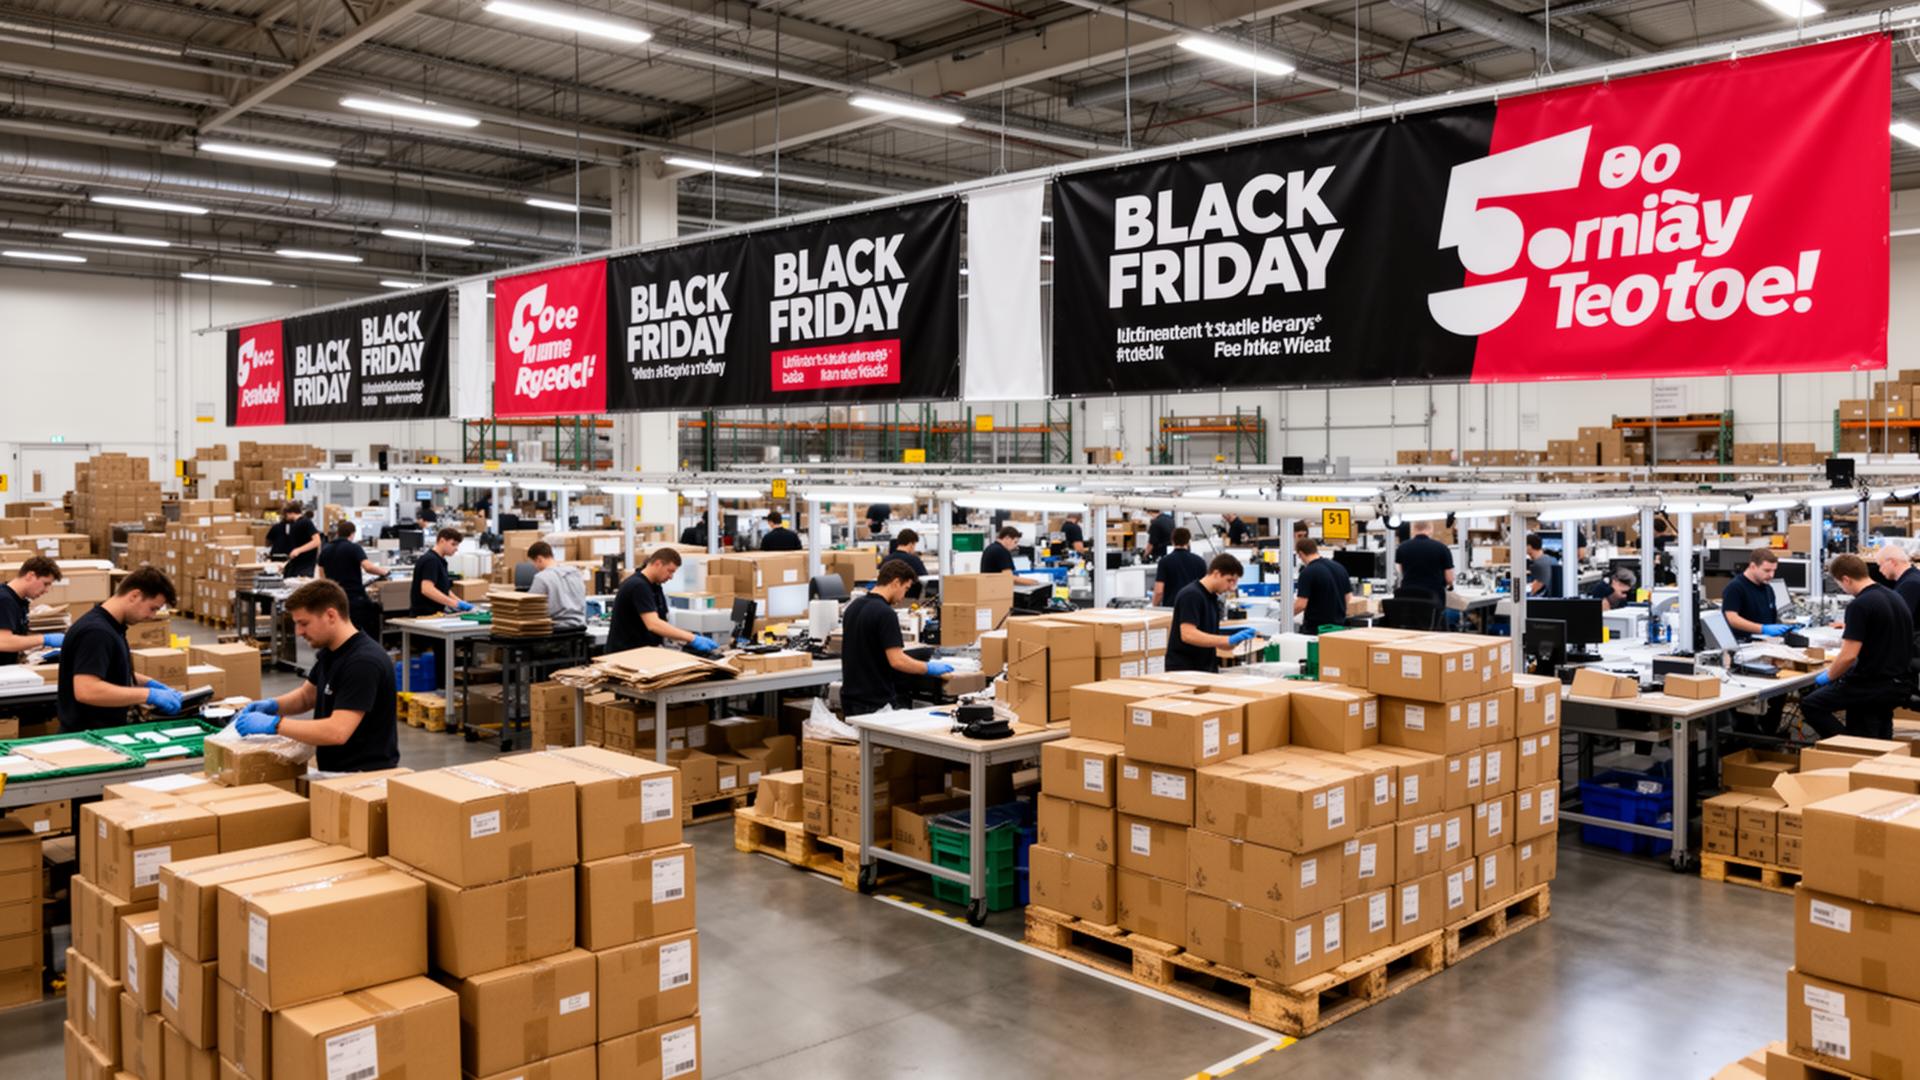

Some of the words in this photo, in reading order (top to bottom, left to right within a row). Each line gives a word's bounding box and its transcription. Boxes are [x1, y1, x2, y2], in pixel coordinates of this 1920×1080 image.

[1114, 165, 1338, 250] BLACK
[774, 233, 906, 298] BLACK
[1109, 228, 1345, 309] FRIDAY
[630, 271, 731, 324] BLACK
[770, 282, 910, 344] FRIDAY
[361, 310, 424, 347] BLACK
[627, 313, 733, 363] FRIDAY
[295, 338, 351, 377] BLACK
[361, 341, 425, 377] FRIDAY
[293, 371, 351, 407] FRIDAY
